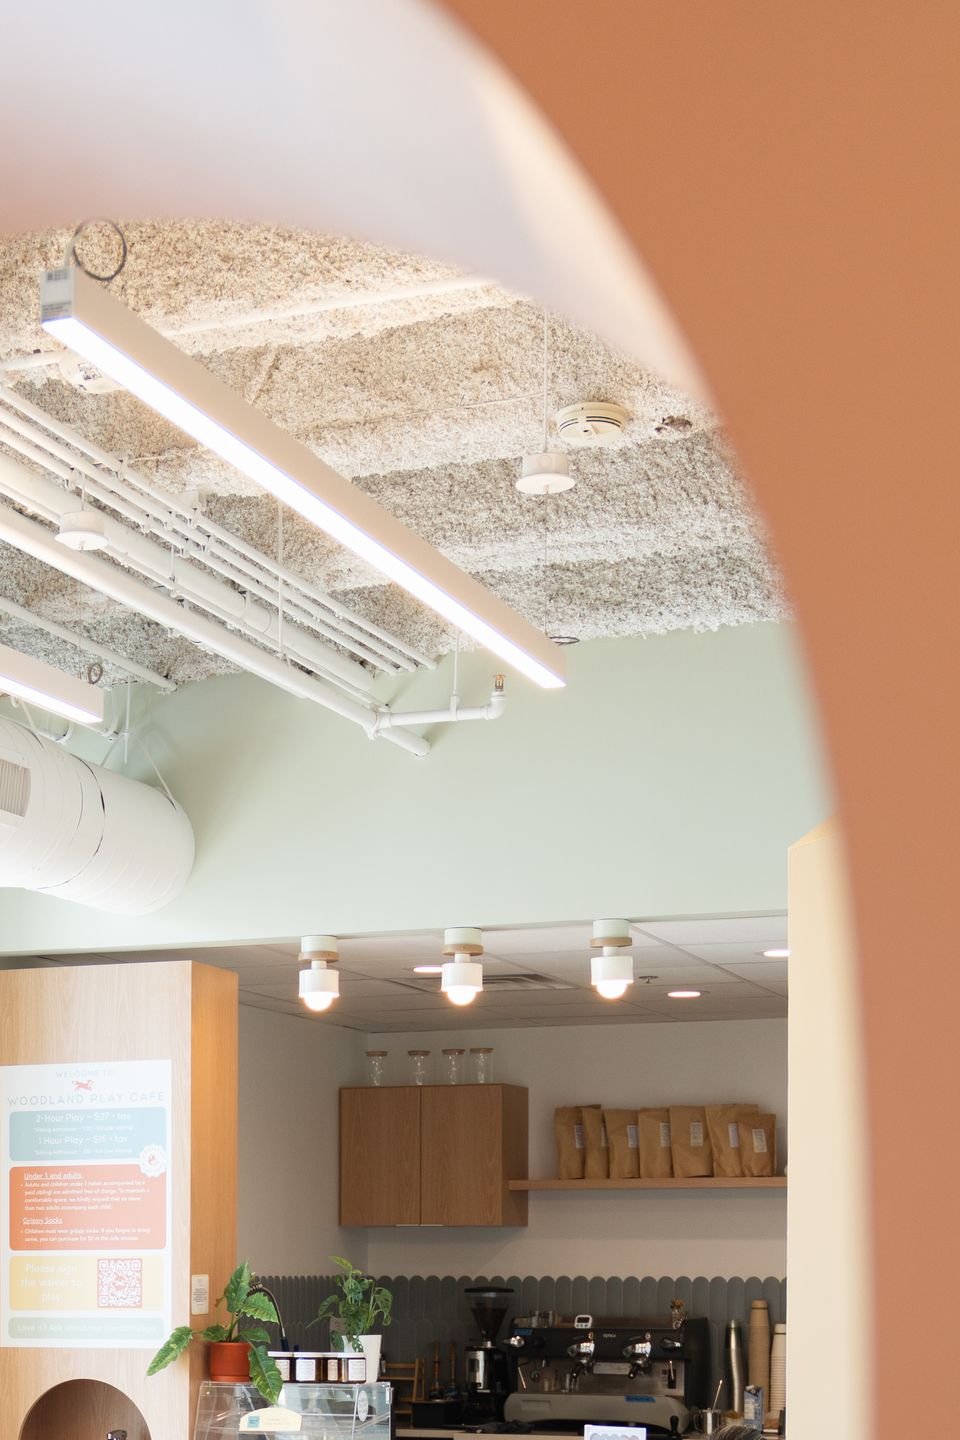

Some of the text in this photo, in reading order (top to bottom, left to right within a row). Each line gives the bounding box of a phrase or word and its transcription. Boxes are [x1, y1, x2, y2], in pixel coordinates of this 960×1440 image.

[56, 1070, 99, 1079] WELCOME
[8, 1091, 165, 1105] WOODLAND PLAY CAFE
[66, 1113, 84, 1123] Play
[94, 1112, 109, 1121] $27
[65, 1136, 83, 1145] Play
[23, 1217, 43, 1225] Grippy
